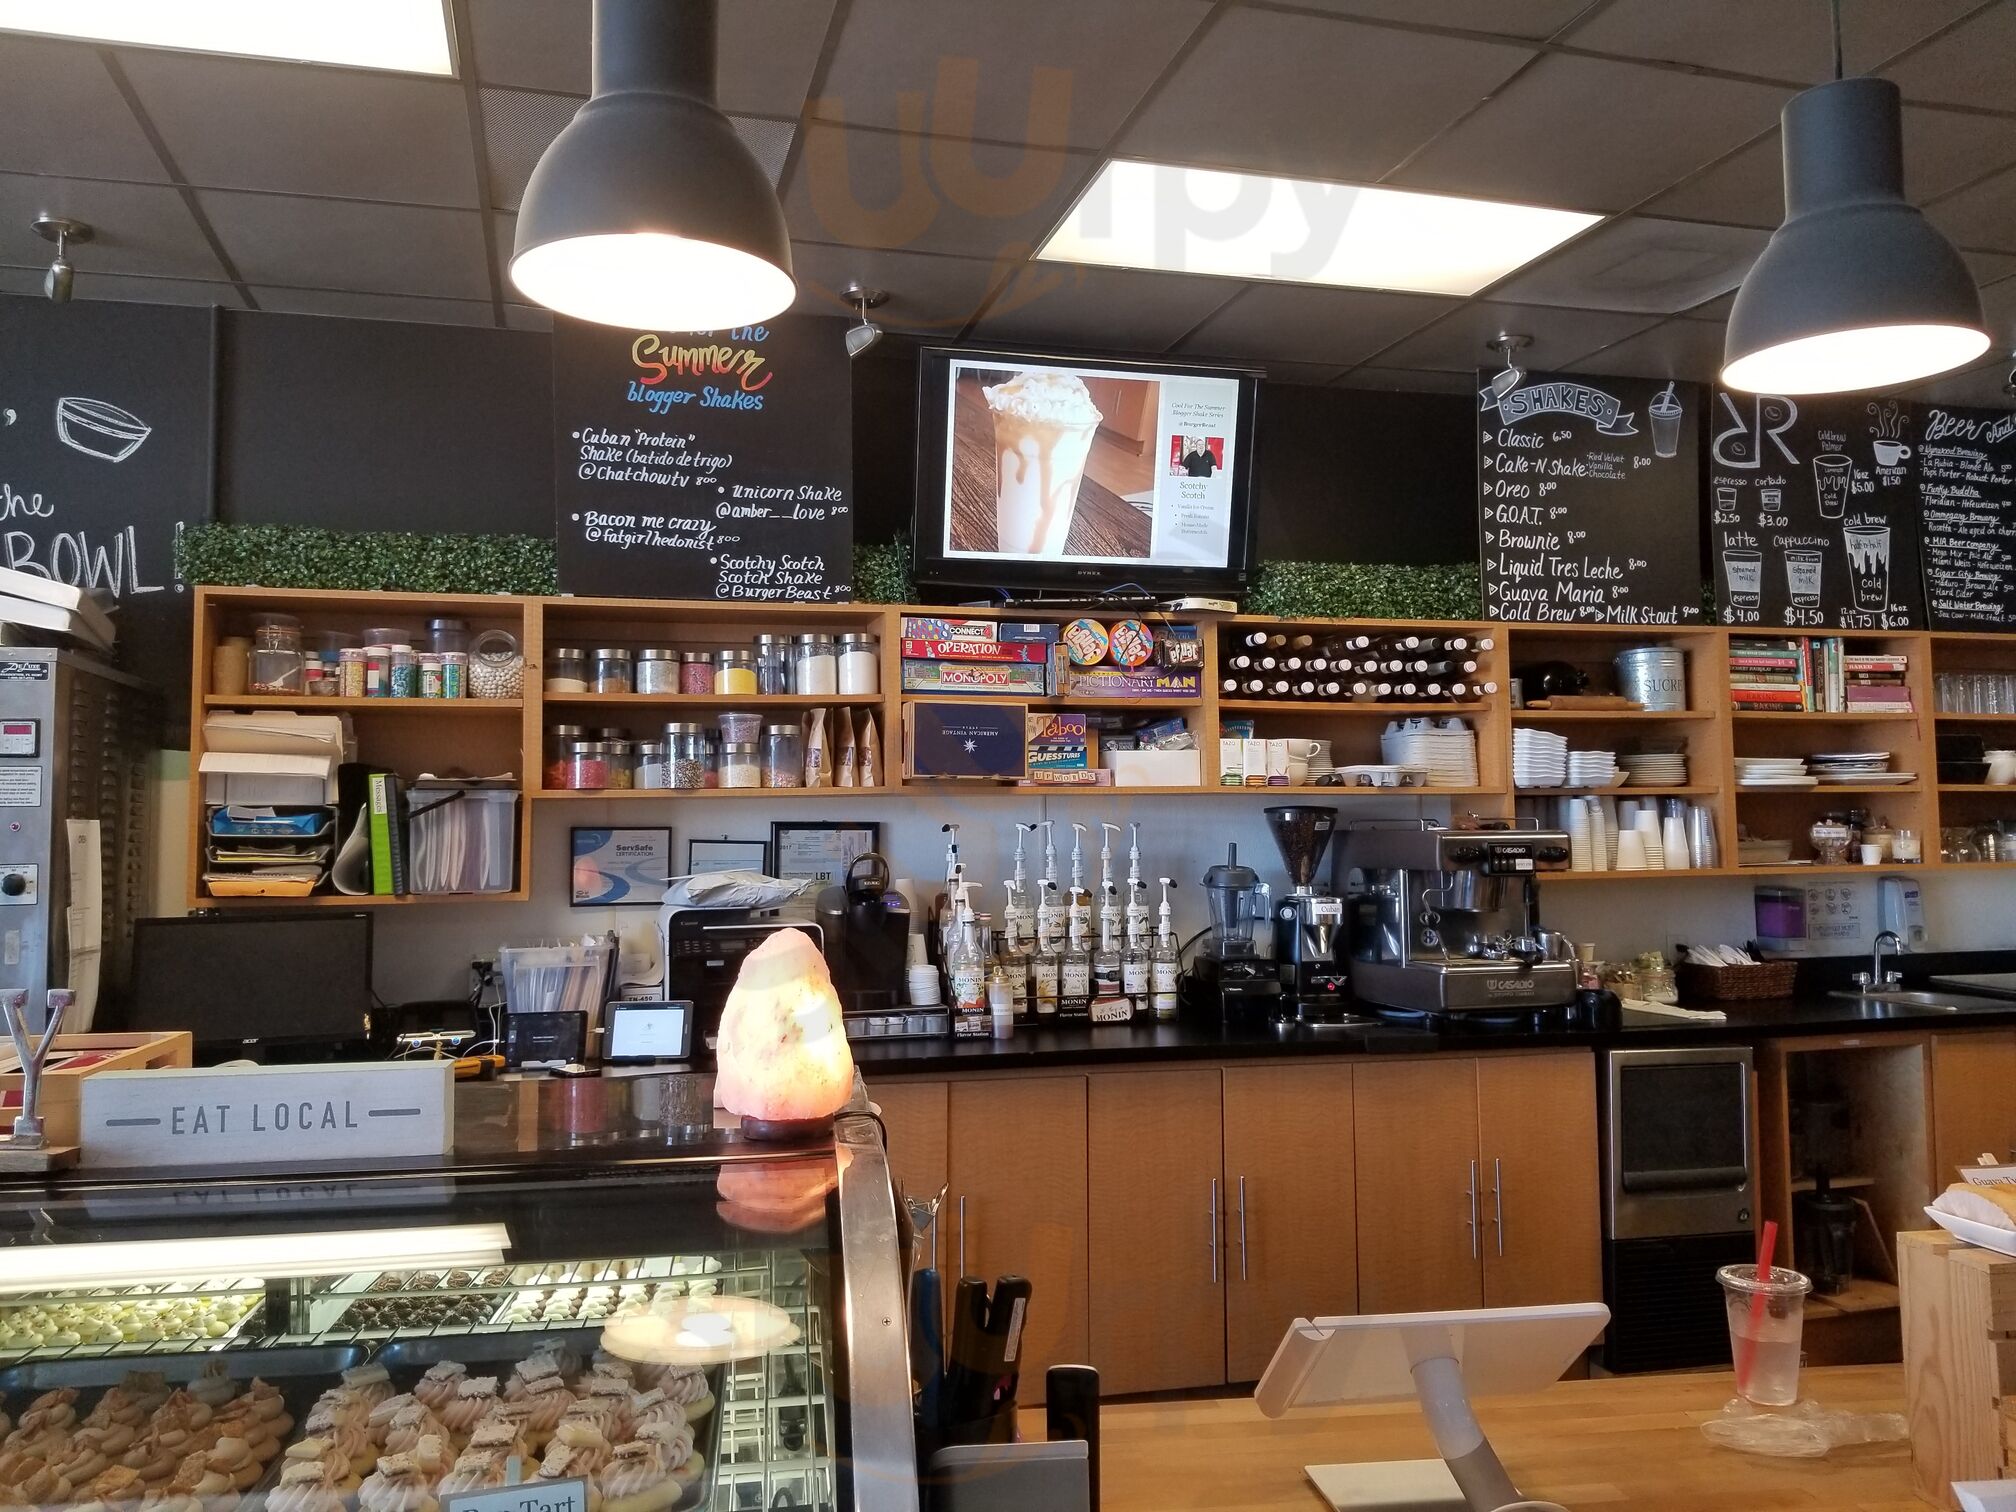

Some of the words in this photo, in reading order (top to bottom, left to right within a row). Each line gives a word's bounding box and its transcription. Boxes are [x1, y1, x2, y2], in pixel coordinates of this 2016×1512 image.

[632, 334, 773, 391] Summer
[699, 386, 764, 410] Shakes
[1508, 384, 1607, 418] SHAKES
[1925, 409, 1991, 441] Beer
[582, 427, 631, 447] Cuban
[1497, 428, 1545, 449] Classic
[580, 445, 623, 462] Shake
[625, 448, 674, 466] (batido
[676, 450, 693, 467] de
[694, 451, 733, 475] trigo)
[1588, 451, 1603, 461] Red
[1603, 452, 1625, 464] Velvet
[1548, 457, 1588, 478] Shake
[1588, 471, 1627, 481] Chocolate
[1754, 475, 1787, 487] cortado
[732, 484, 796, 502] Unicorn
[797, 484, 843, 502] Shake
[1179, 481, 1208, 492] Scotchy
[1495, 480, 1531, 499] Oreo
[1180, 490, 1206, 500] Scotch
[584, 511, 636, 529] Bacon
[641, 514, 665, 529] me
[668, 516, 718, 541] crazy
[1757, 511, 1789, 528] $3.00
[1843, 513, 1862, 527] cold
[1864, 511, 1888, 525] brew
[1498, 528, 1561, 551] Brownie
[1724, 531, 1760, 548] latte
[1773, 535, 1830, 550] cappuccino
[720, 553, 776, 579] Scotchy
[779, 554, 827, 571] Scotch
[1499, 552, 1545, 583] Liquid
[1548, 557, 1580, 578] Tres
[1583, 556, 1624, 580] Leche
[719, 570, 770, 586] Scotch
[774, 571, 825, 585] Shake
[1499, 581, 1549, 602] Guava
[1555, 581, 1606, 604] Maria
[1860, 590, 1884, 602] brew
[1499, 602, 1532, 622] Cold
[1536, 603, 1577, 622] Brew
[1606, 605, 1639, 624] Milk
[1640, 606, 1679, 625] Stout
[949, 625, 983, 637] CONNECT
[937, 641, 1002, 656] OPERATION
[942, 671, 1008, 685] MONOPOLY
[1079, 674, 1155, 690] PICTIONARY
[1157, 676, 1196, 689] MAN
[1643, 678, 1684, 692] SUCRE
[968, 729, 999, 737] AMERICAN
[1029, 751, 1082, 765] GUESSTURES
[616, 844, 655, 852] ServSafe
[815, 872, 831, 881] LBT
[1061, 998, 1088, 1006] MONIN
[1096, 1009, 1127, 1021] MONIN
[171, 1105, 231, 1134] EAT
[252, 1100, 358, 1132] LOCAL
